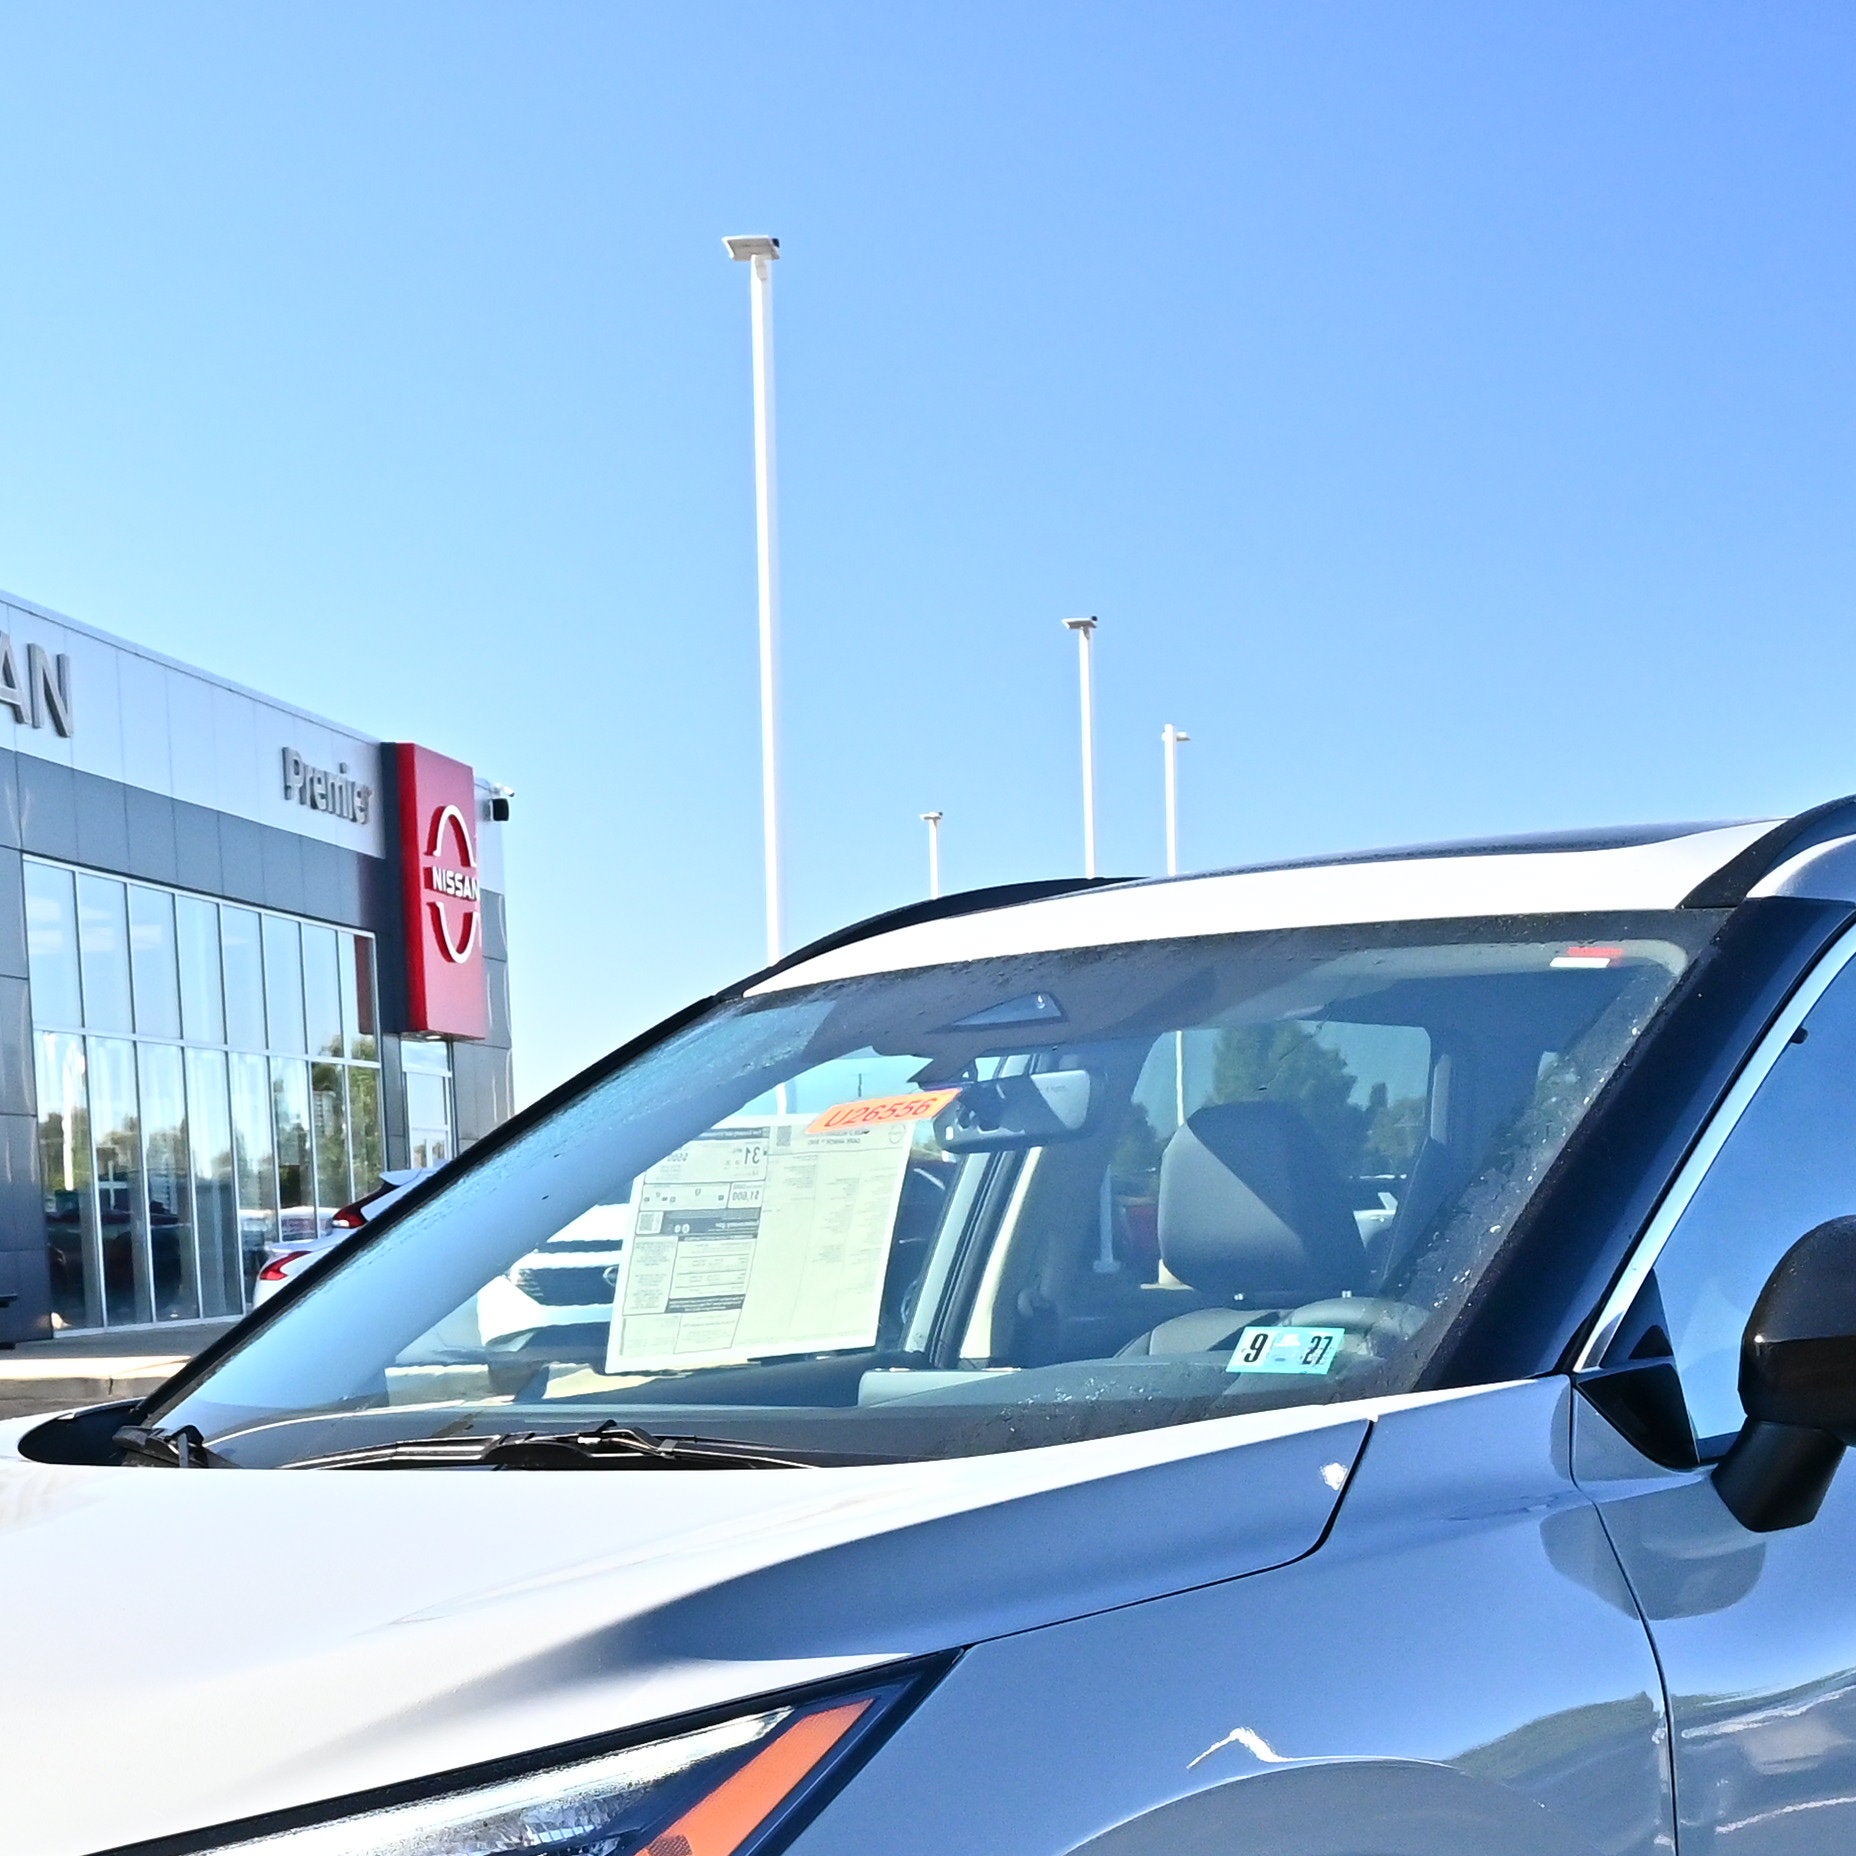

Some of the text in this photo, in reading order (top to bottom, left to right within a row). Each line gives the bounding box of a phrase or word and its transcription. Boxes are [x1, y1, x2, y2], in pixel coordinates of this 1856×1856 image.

[282, 747, 373, 825] Premier
[430, 866, 480, 901] NISSAN
[824, 1097, 937, 1127] U26556
[1244, 1333, 1333, 1365] 9 27
